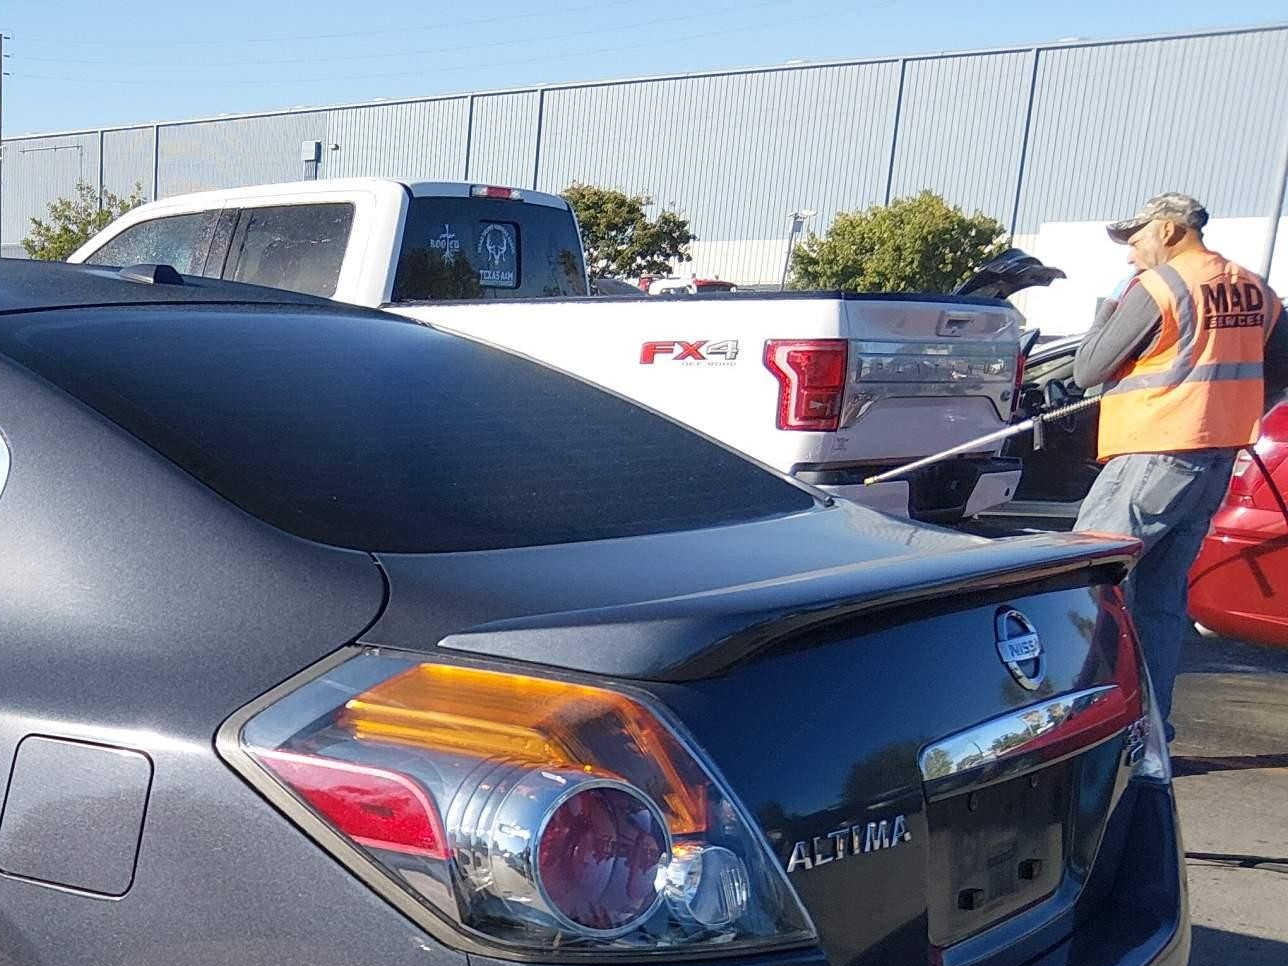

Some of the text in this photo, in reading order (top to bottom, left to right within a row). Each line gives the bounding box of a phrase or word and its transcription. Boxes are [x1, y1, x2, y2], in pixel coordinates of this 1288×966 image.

[479, 269, 500, 281] TEXAS
[1200, 282, 1264, 315] MAD
[639, 339, 740, 365] FX4
[785, 813, 912, 874] ALTIMA
